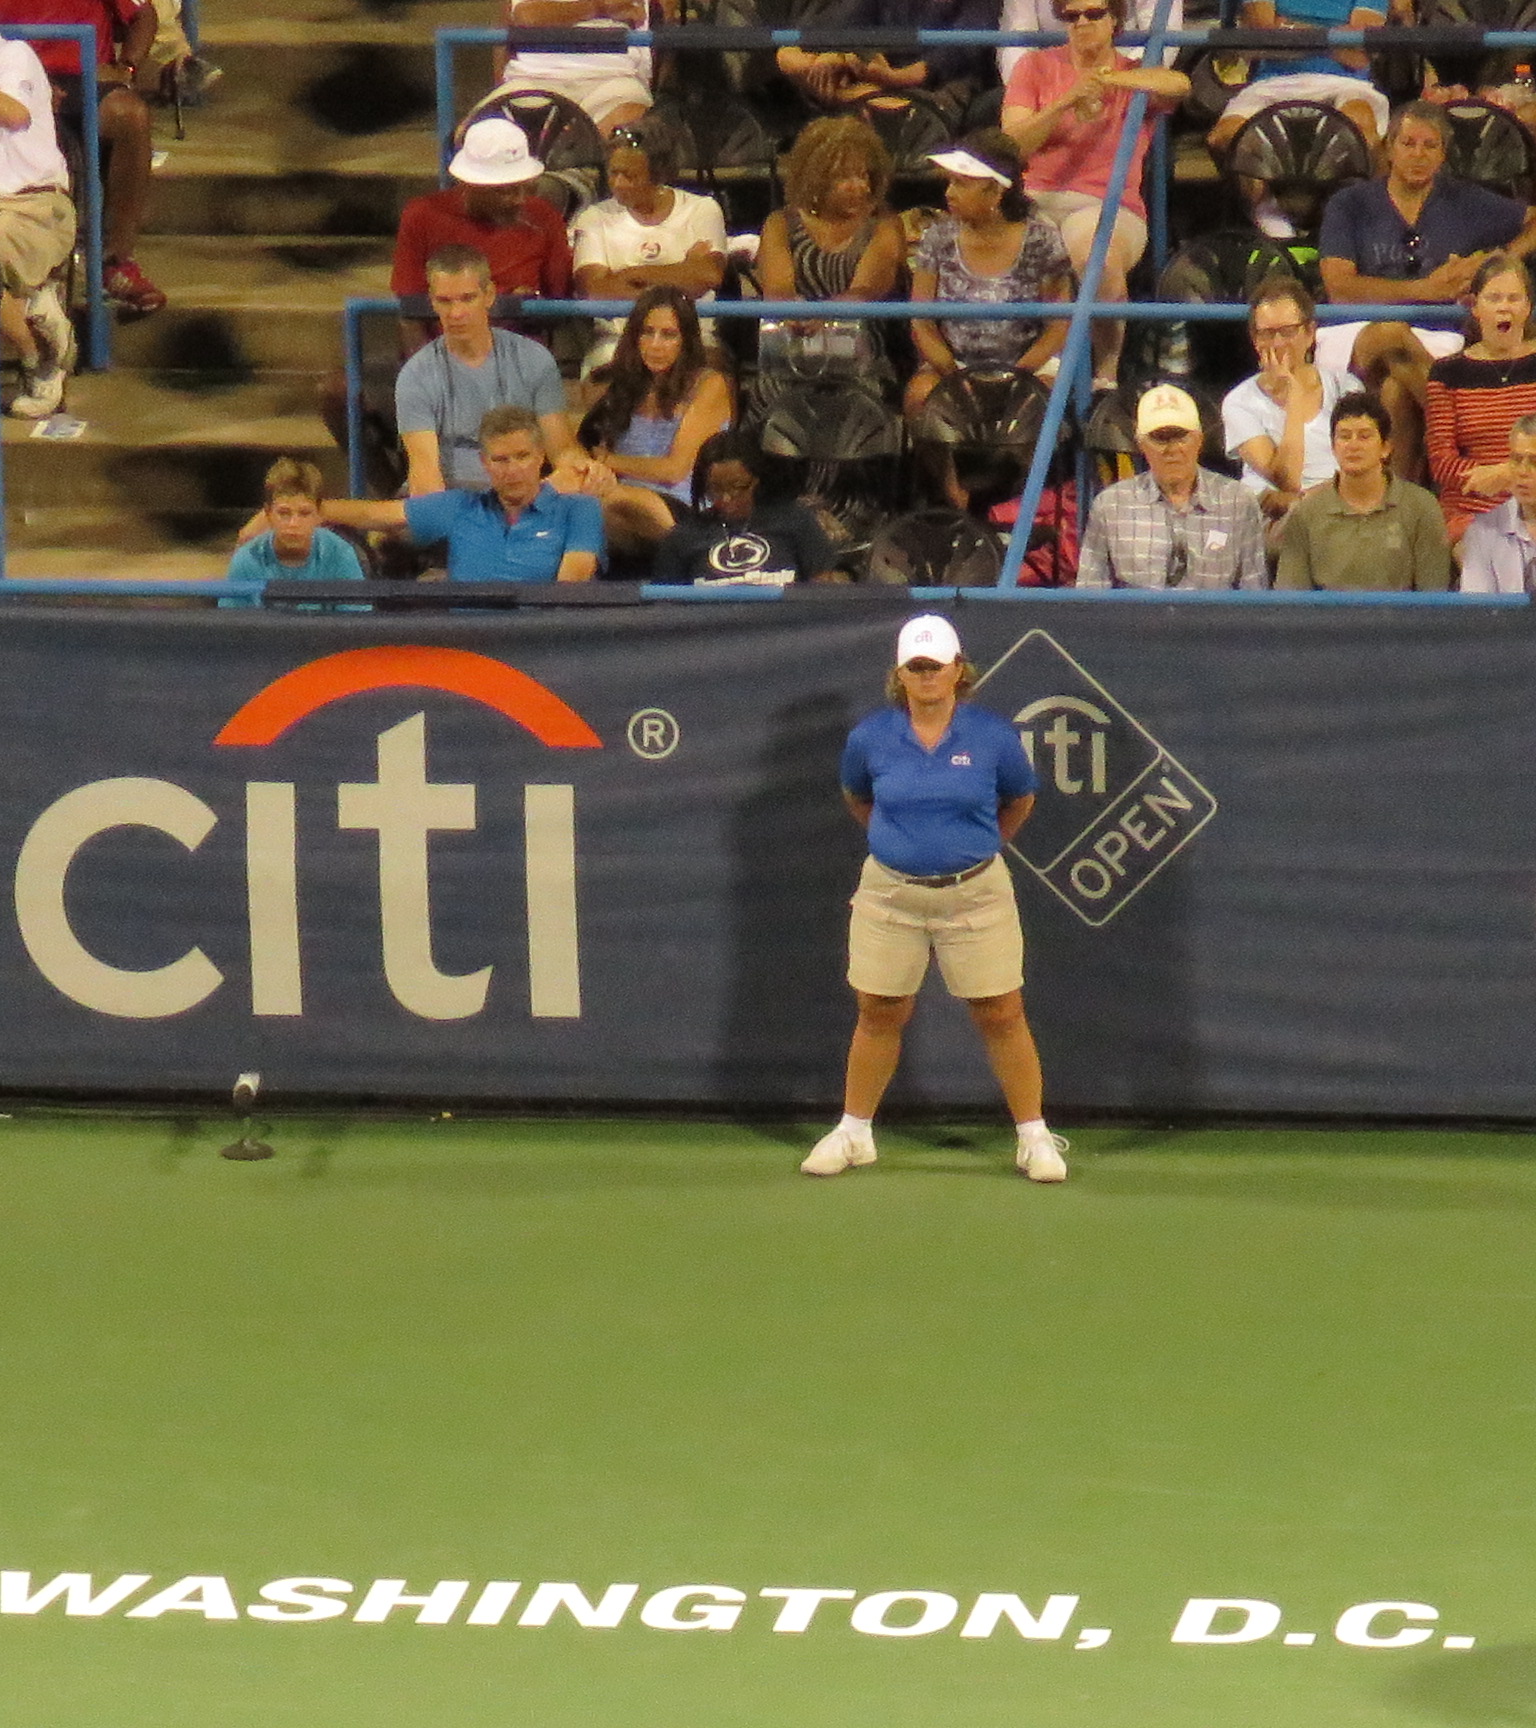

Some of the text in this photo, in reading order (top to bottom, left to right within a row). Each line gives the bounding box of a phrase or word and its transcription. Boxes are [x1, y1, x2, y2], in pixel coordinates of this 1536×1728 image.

[14, 710, 581, 1020] citi
[1070, 776, 1194, 899] OPEN
[0, 1570, 1476, 1650] WASHINGTON, D.C.
